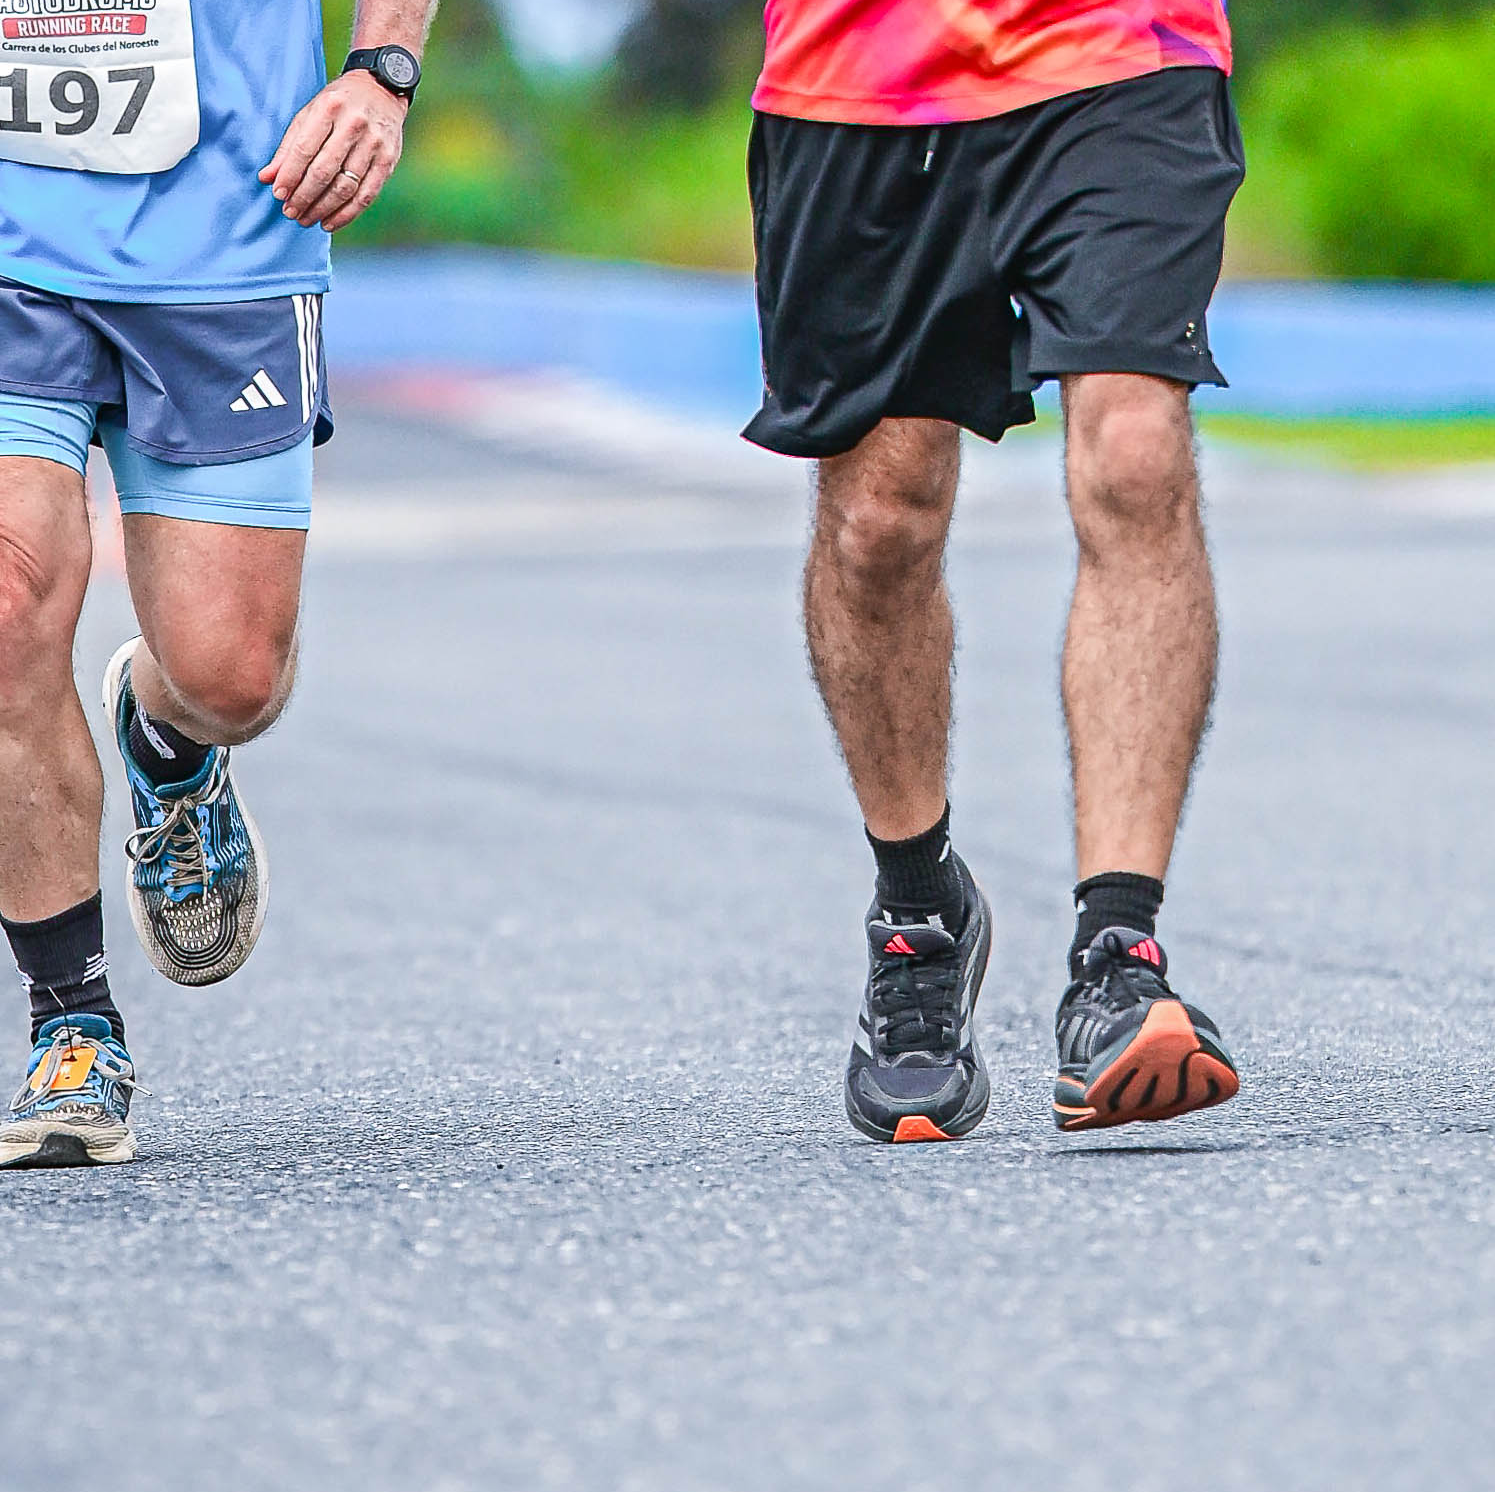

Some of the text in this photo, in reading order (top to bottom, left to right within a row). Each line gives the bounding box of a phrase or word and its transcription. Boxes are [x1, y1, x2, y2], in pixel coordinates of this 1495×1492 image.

[17, 15, 131, 37] RUNNING RACE
[2, 42, 36, 52] Carrera
[38, 43, 51, 53] de
[53, 44, 66, 54] los
[68, 43, 101, 54] Clubes
[102, 41, 117, 51] del
[119, 38, 160, 50] Noroeste
